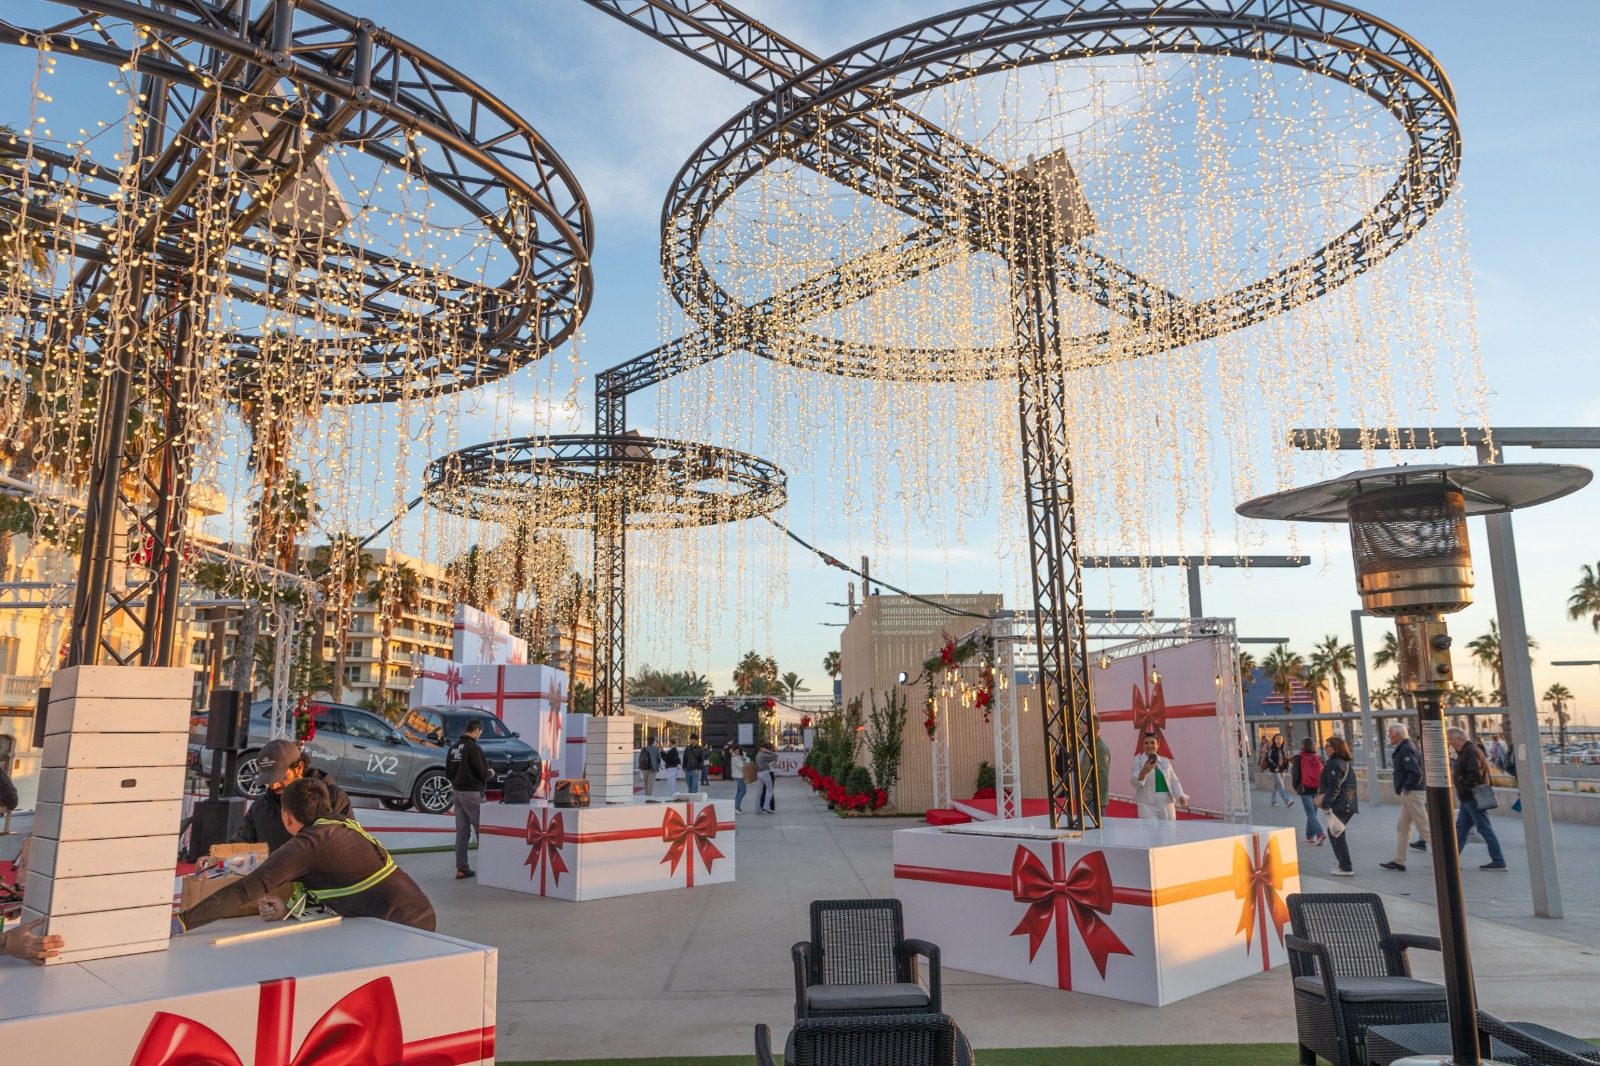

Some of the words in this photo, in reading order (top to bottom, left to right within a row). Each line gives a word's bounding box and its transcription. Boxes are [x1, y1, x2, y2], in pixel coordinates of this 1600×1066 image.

[311, 749, 338, 761] Benigar
[366, 753, 399, 775] iX2
[774, 760, 798, 772] ajo
